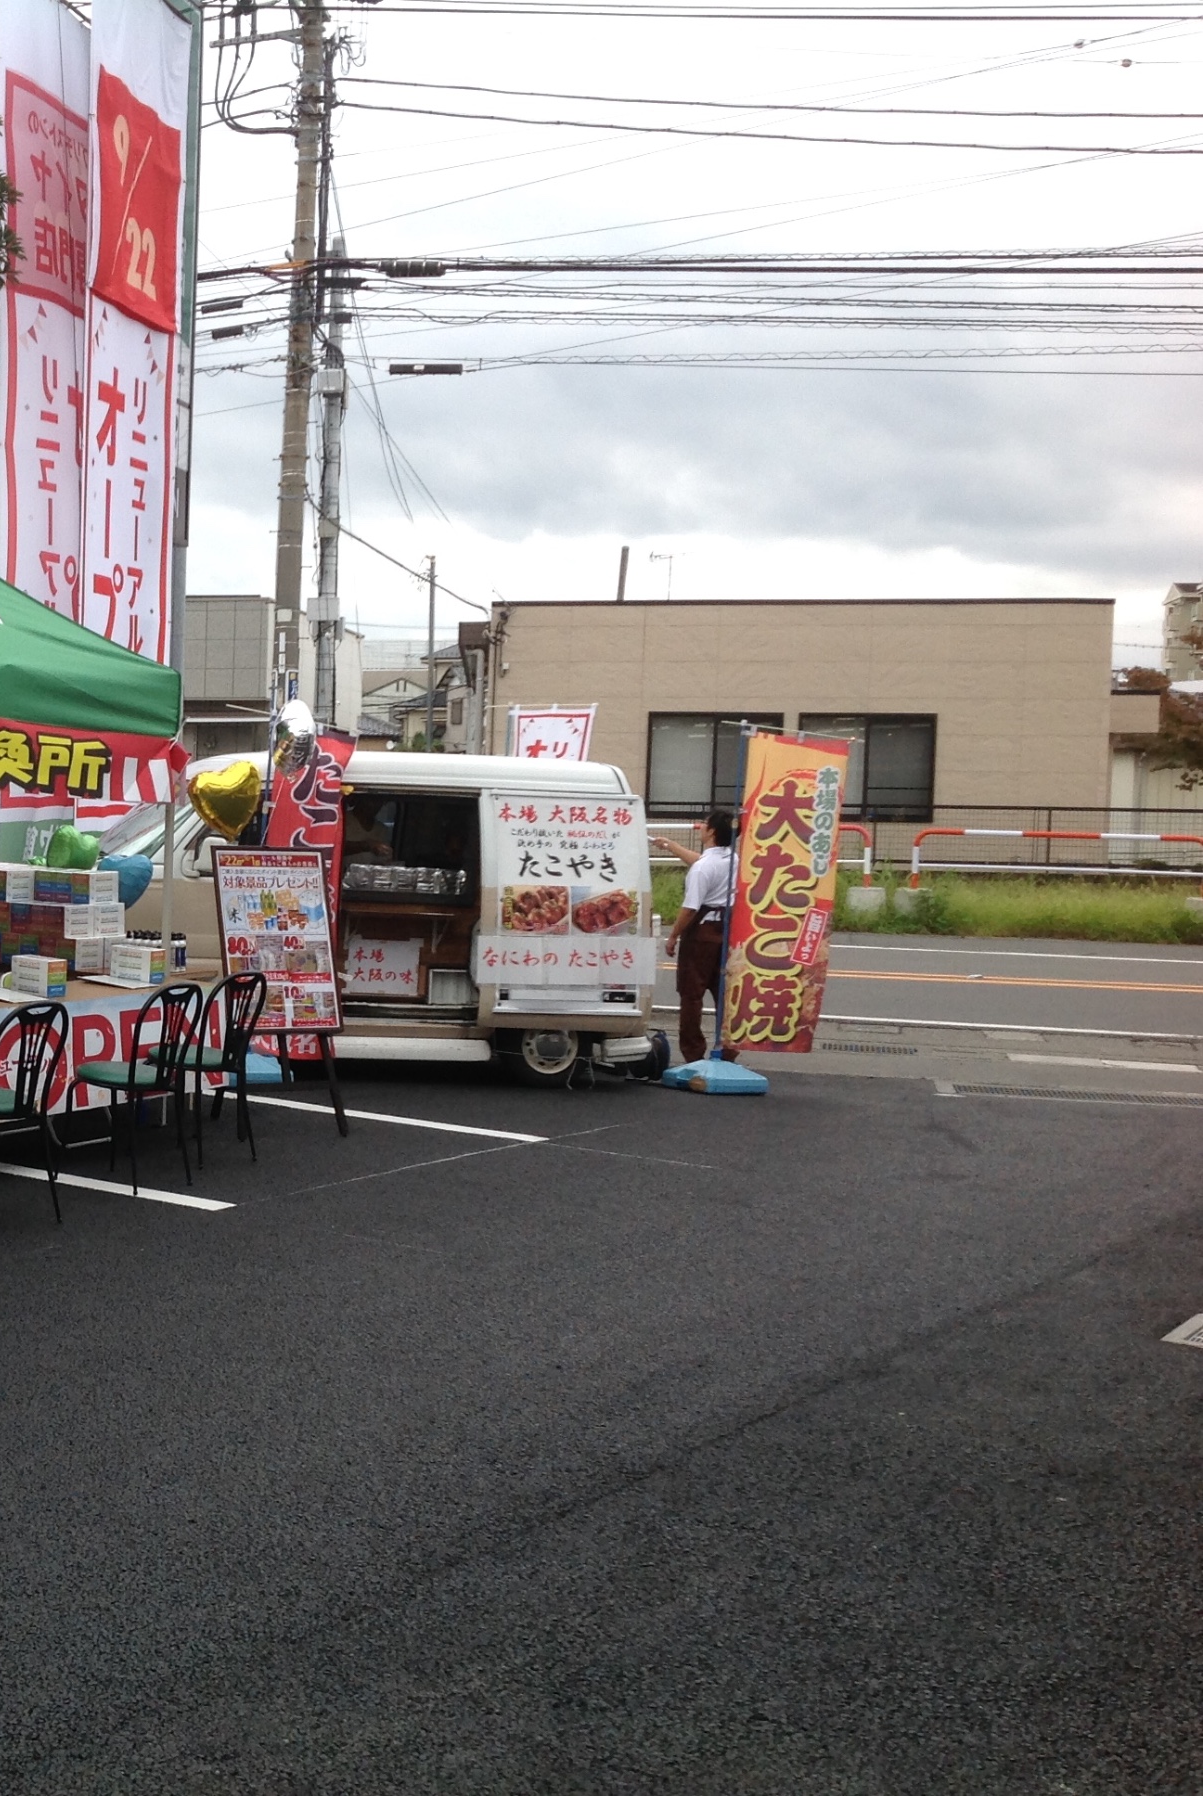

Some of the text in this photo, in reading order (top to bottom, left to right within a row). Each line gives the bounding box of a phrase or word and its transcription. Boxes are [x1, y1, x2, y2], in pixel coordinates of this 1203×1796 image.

[112, 114, 157, 303] 9/22
[92, 366, 126, 641] オープ
[127, 378, 152, 655] リニューアル
[498, 802, 632, 825] 本場 大阪名物
[812, 767, 840, 875] 本場のあじ
[223, 875, 318, 889] 対象景品プレゼント!!
[518, 850, 618, 883] たこやき
[729, 779, 816, 1038] 大たこ焼
[353, 946, 385, 963] 本場
[482, 946, 636, 970] なにわの たこやき
[352, 967, 415, 985] 大阪の味
